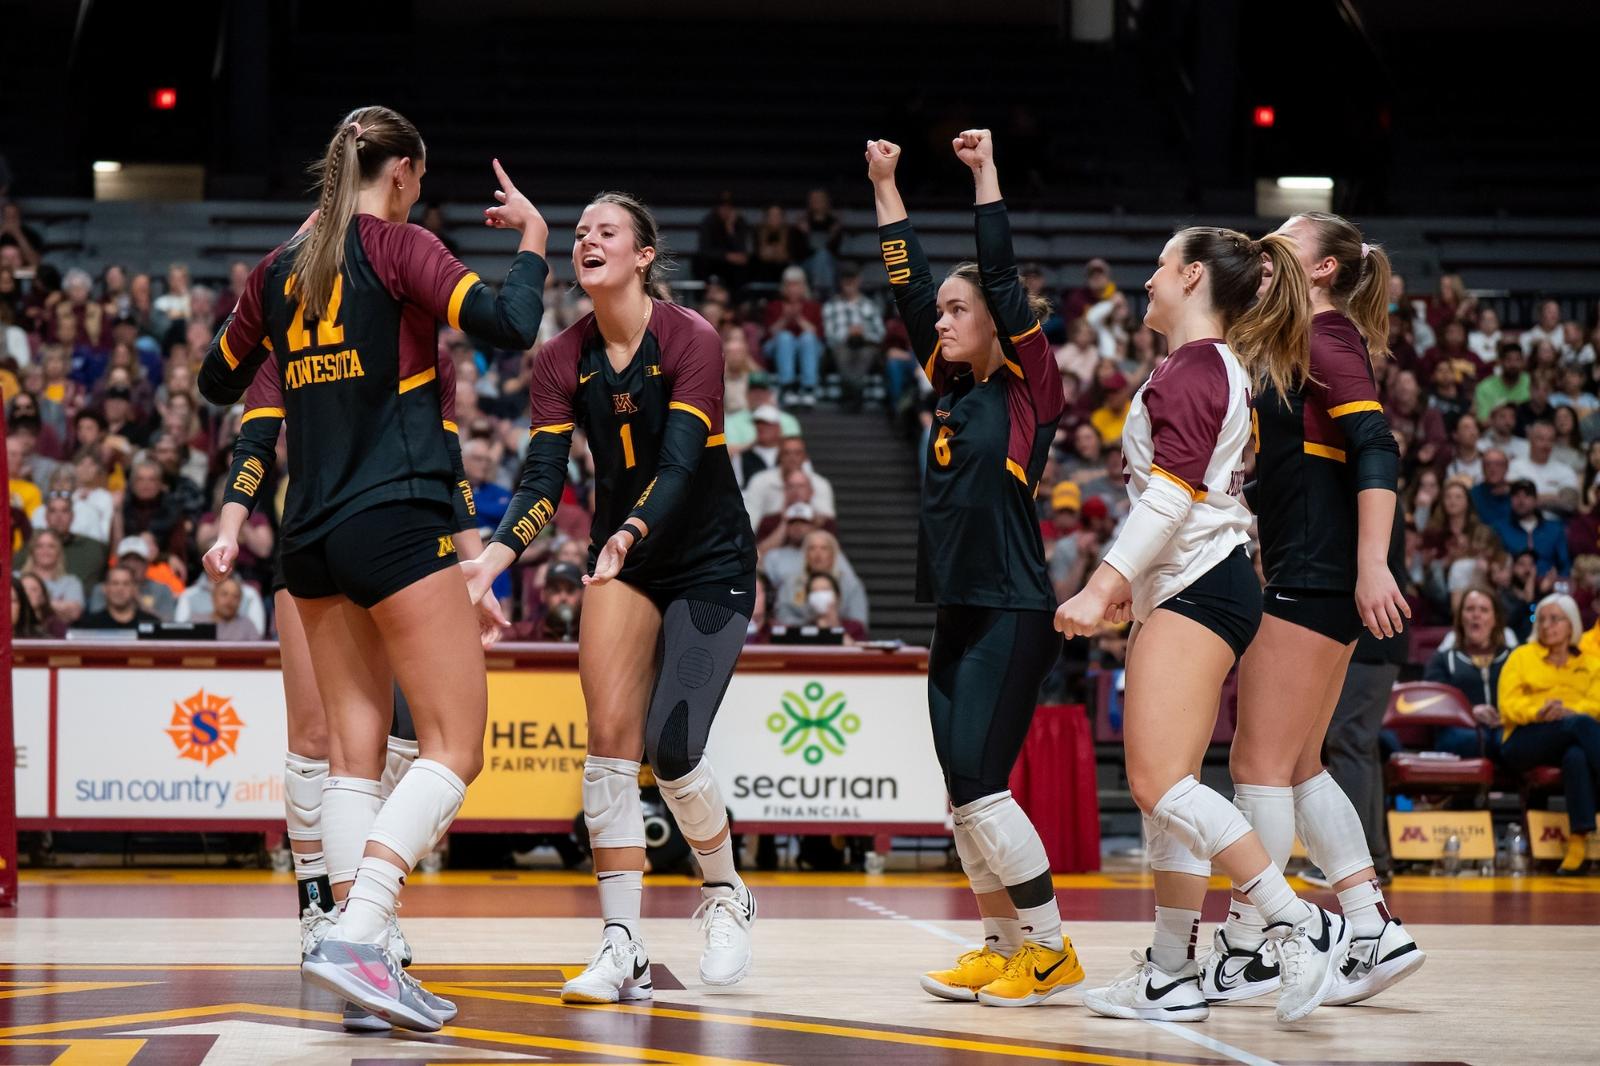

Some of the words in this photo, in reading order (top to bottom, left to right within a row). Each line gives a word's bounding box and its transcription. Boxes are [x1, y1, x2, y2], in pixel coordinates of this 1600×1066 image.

[881, 239, 911, 284] GOLD
[620, 423, 636, 469] 1
[934, 425, 954, 466] 6
[512, 497, 555, 546] GOLDEN
[437, 535, 456, 557] M
[191, 710, 219, 746] S
[492, 722, 587, 749] HEAL
[76, 778, 123, 801] sun
[127, 774, 231, 809] country
[235, 774, 284, 802] airli
[733, 775, 898, 799] securian
[764, 806, 861, 818] FINANCIAL
